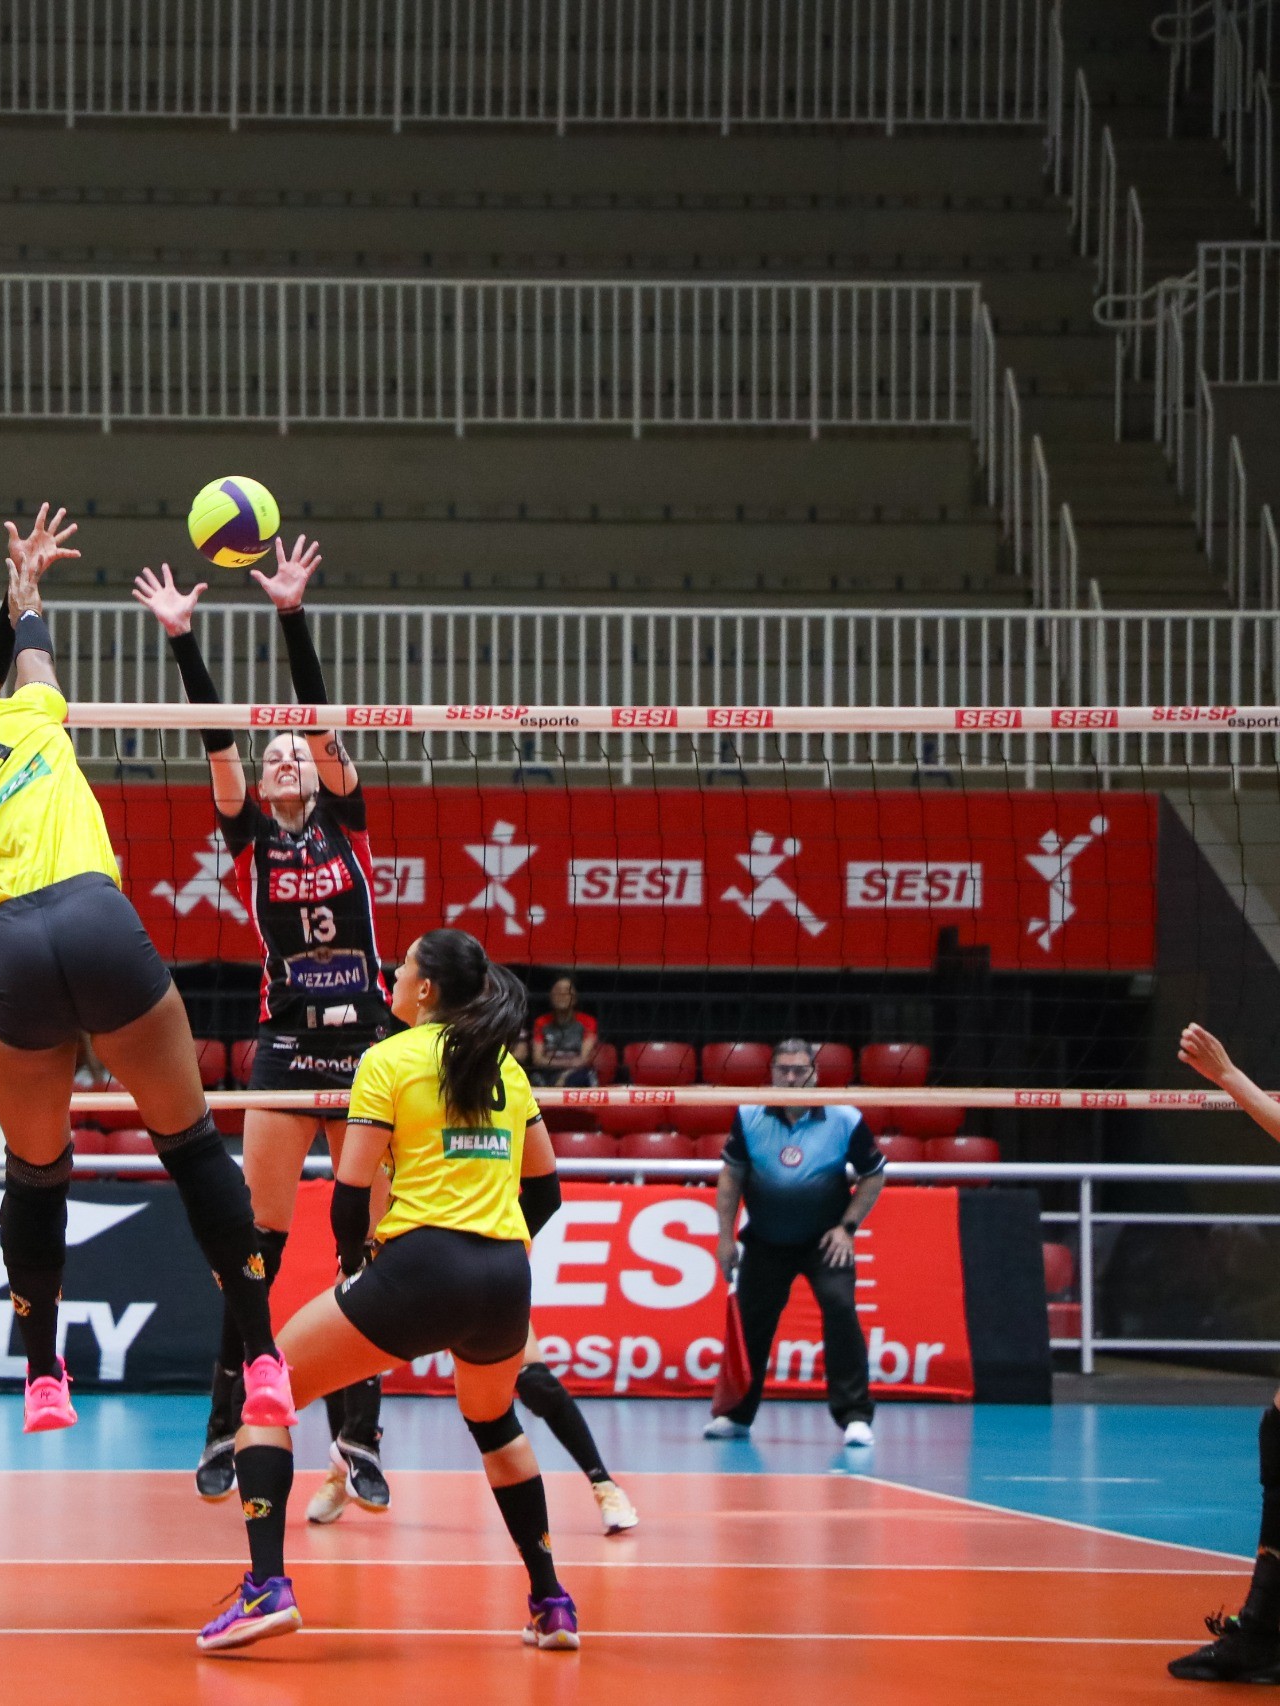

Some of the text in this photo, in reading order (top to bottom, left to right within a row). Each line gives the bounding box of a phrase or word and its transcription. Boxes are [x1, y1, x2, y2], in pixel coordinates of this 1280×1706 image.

[256, 709, 311, 725] SESI
[353, 709, 407, 726] SESI
[446, 706, 528, 720] SESI-SP
[618, 710, 672, 727] SESI
[713, 711, 768, 727] SESI
[960, 711, 1016, 728] SESI
[1058, 711, 1112, 728] SESI
[1152, 707, 1236, 720] SESI-SP
[520, 715, 579, 729] esporte
[1228, 716, 1280, 728] esport
[276, 862, 343, 899] SESI
[372, 864, 411, 898] SI
[581, 867, 689, 898] SESI
[860, 869, 968, 902] SESI
[300, 906, 337, 944] 13
[289, 1055, 360, 1072] Mond
[319, 1093, 351, 1105] SES
[568, 1091, 607, 1103] SESI
[634, 1091, 671, 1103] SESI
[1019, 1093, 1057, 1105] SESI
[1086, 1094, 1123, 1106] SESI
[1202, 1101, 1237, 1109] esport
[450, 1136, 507, 1151] HELIAR
